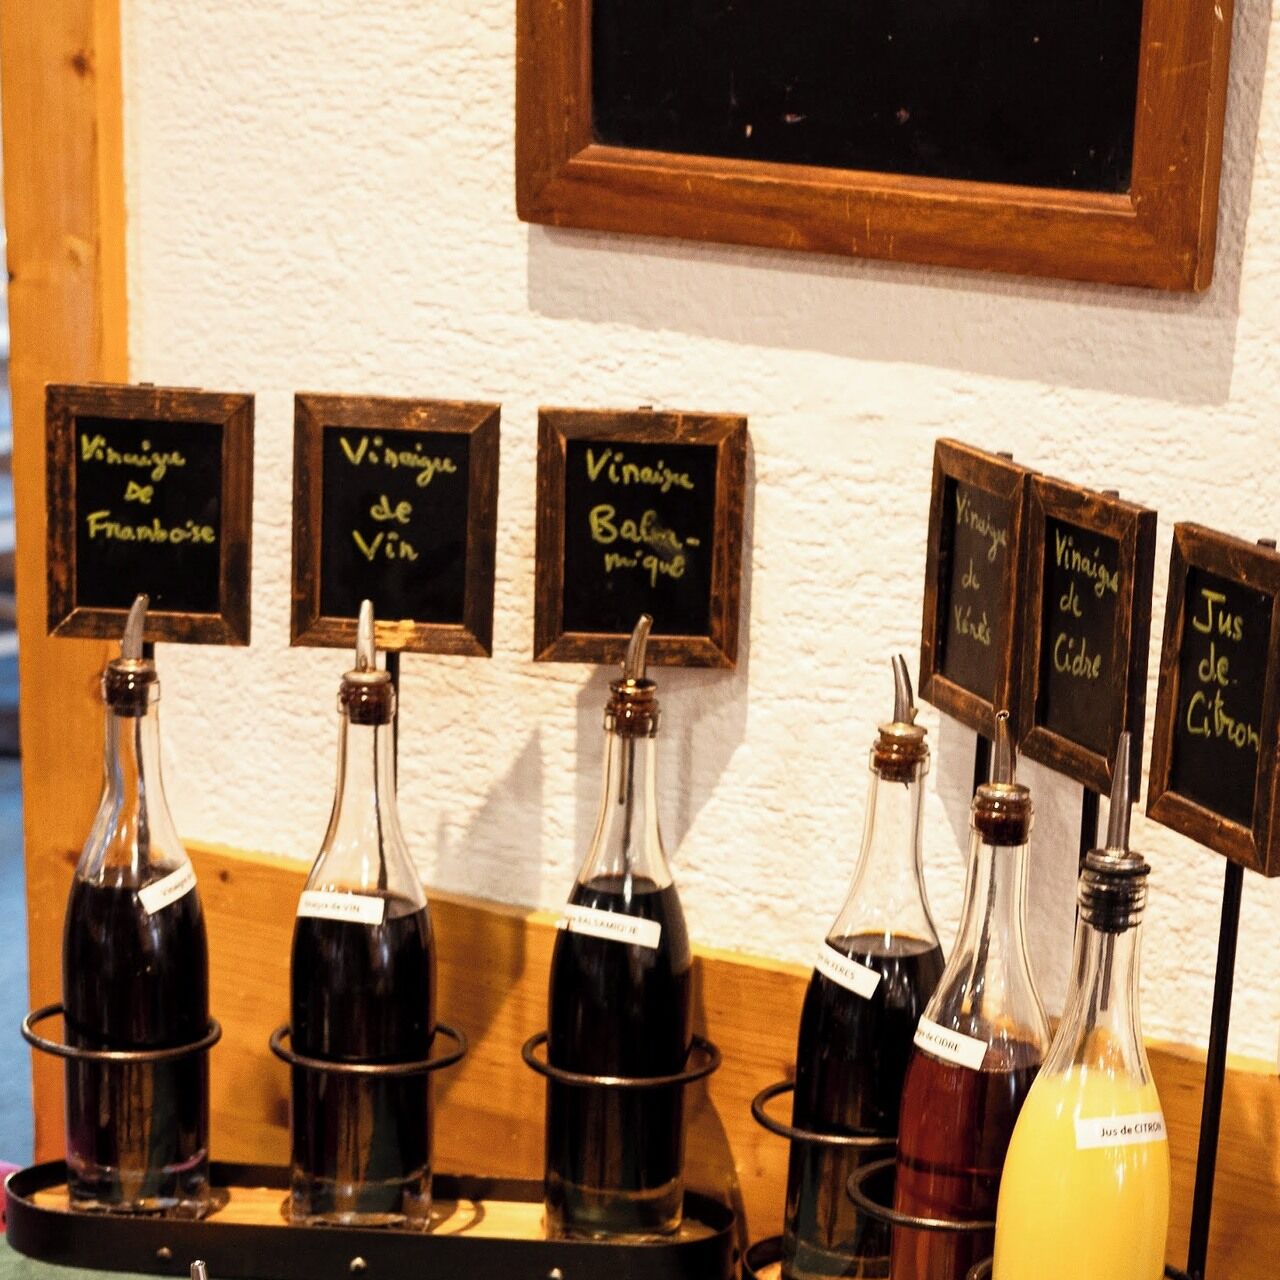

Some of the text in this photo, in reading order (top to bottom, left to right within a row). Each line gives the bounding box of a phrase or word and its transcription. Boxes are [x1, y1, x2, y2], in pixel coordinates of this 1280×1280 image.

[370, 494, 412, 523] de
[86, 510, 216, 543] Framboise
[352, 530, 419, 561] Vin
[961, 558, 980, 589] de
[1060, 582, 1082, 617] de
[1192, 588, 1244, 641] Jus
[1054, 632, 1101, 679] Cidre
[1198, 641, 1230, 686] de
[1187, 690, 1261, 752] Citron
[1102, 1128, 1118, 1137] Jus
[1120, 1125, 1133, 1135] de
